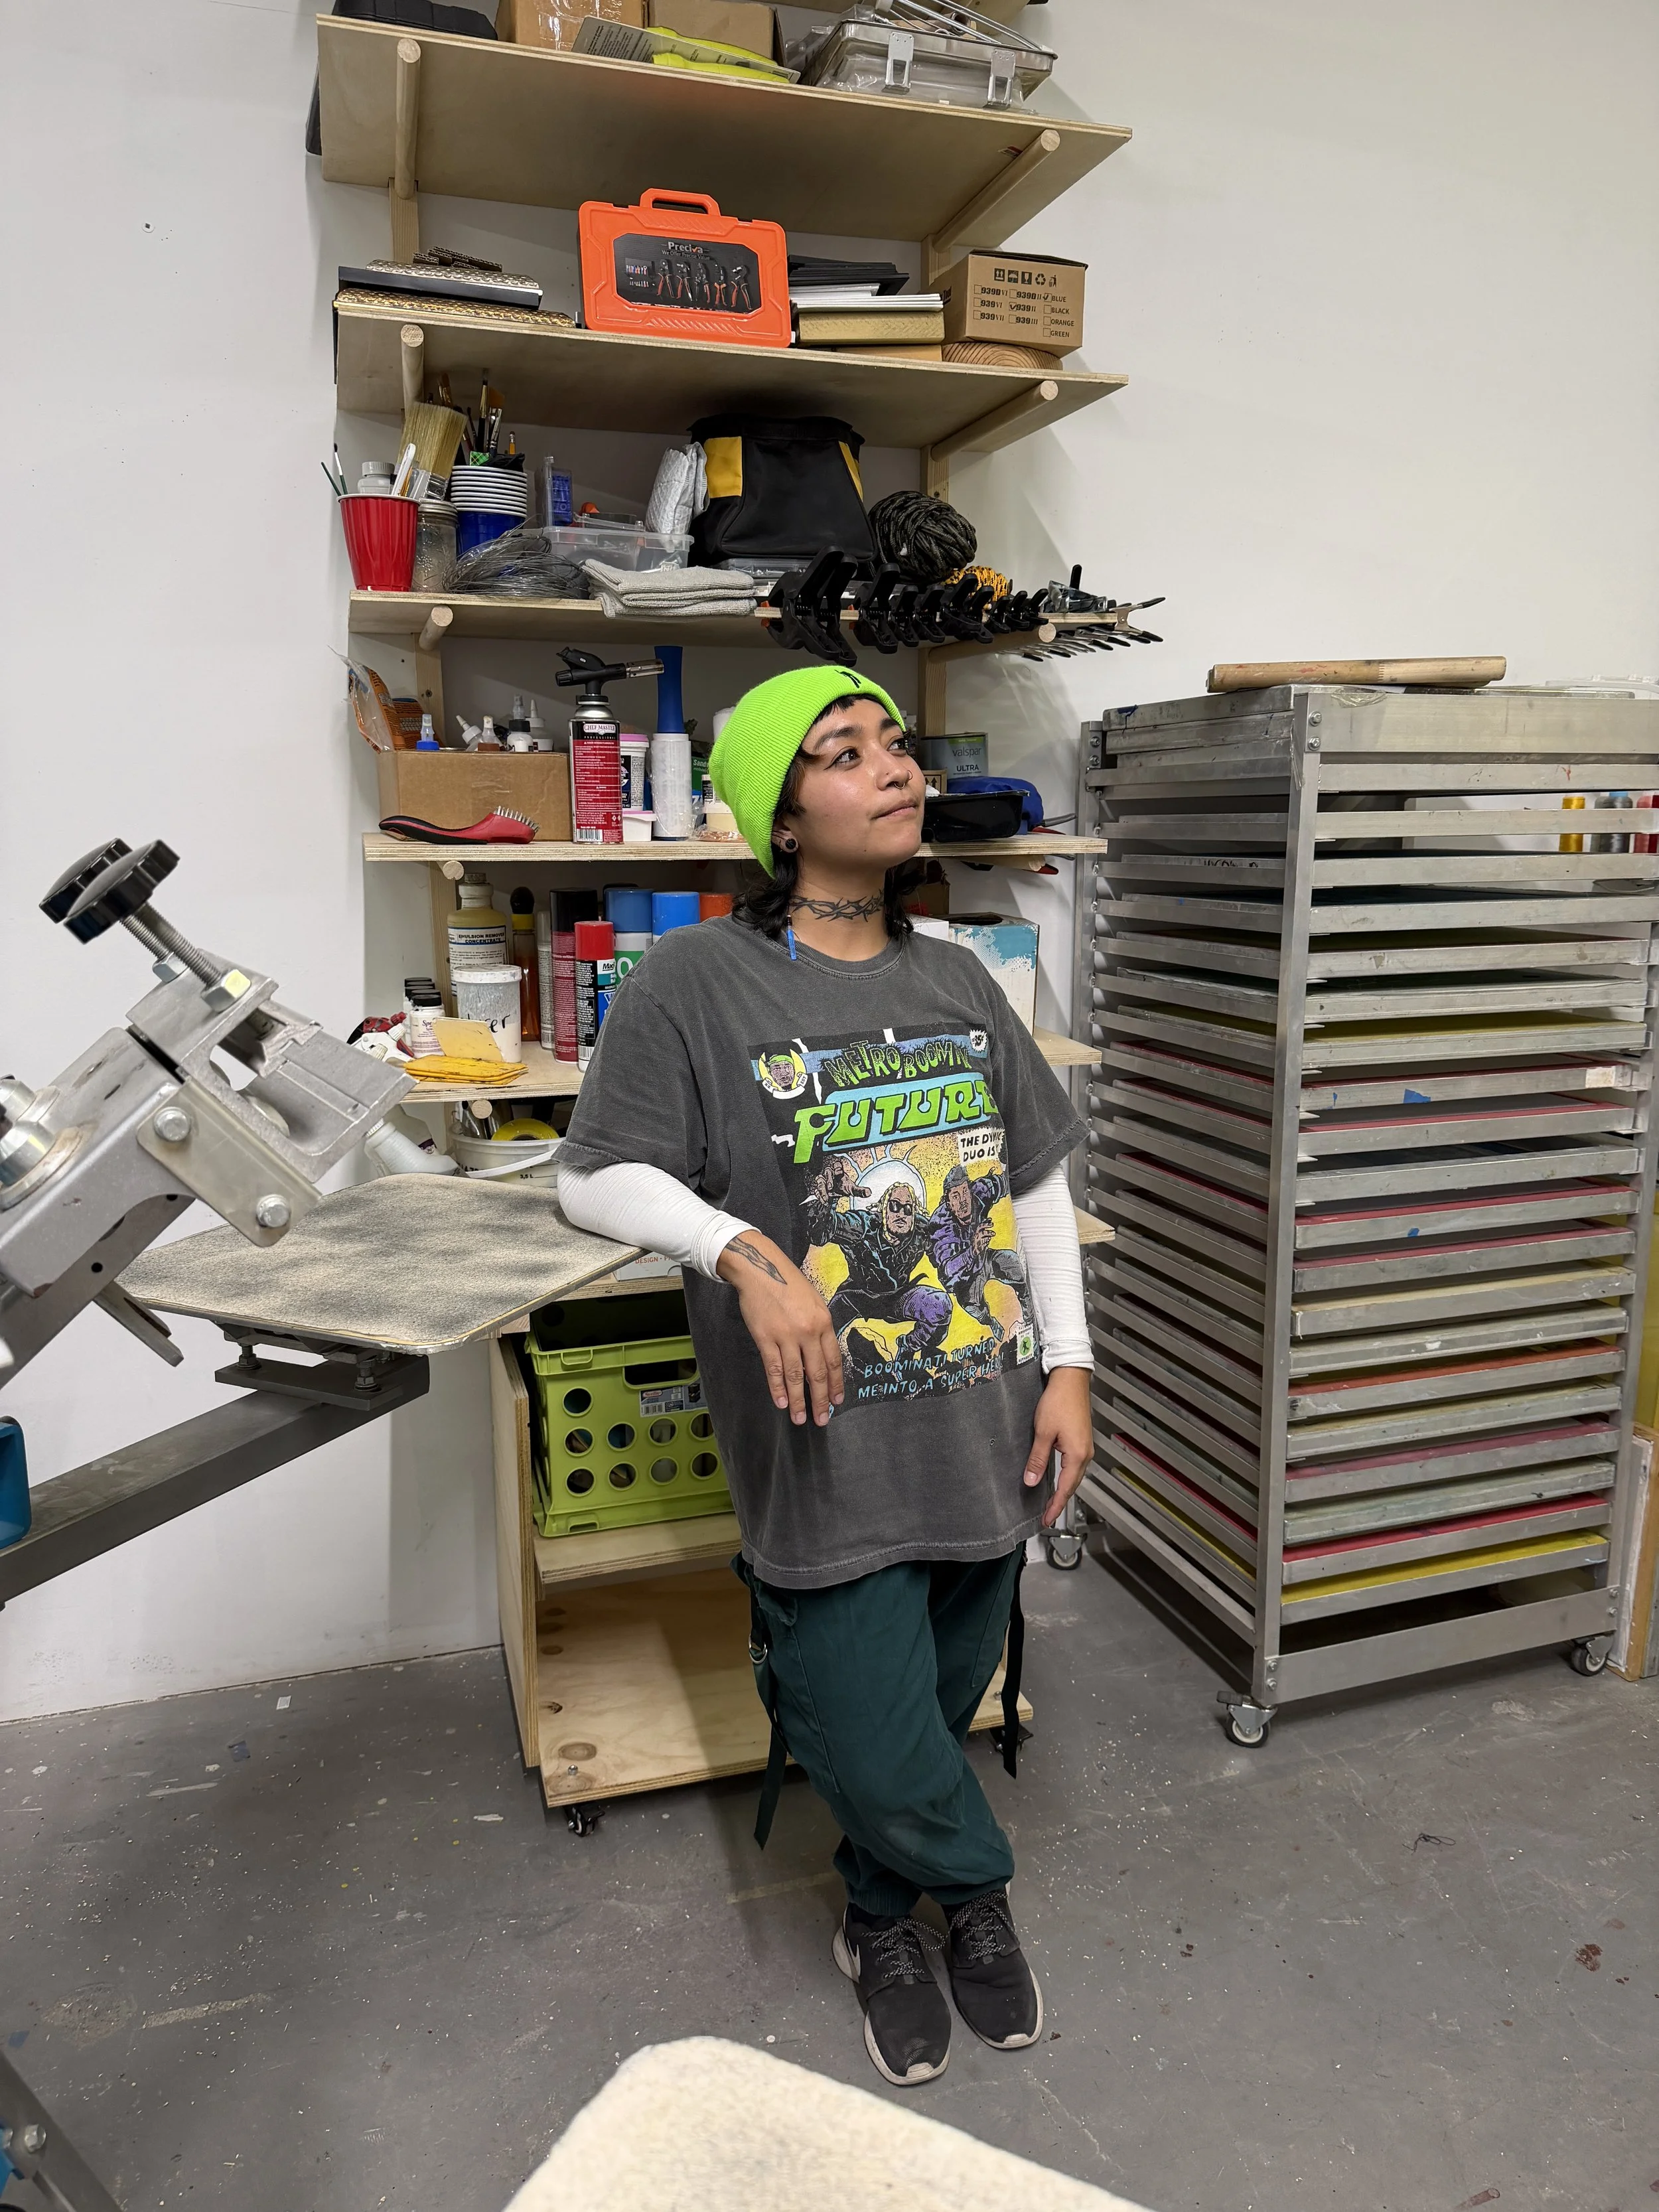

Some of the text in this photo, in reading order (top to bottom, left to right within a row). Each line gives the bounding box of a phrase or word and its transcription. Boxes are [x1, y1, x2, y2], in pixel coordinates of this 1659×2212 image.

[952, 746, 983, 758] valspar
[824, 1040, 901, 1087] METRO
[794, 1080, 999, 1163] FUTURE
[960, 1136, 980, 1148] THE
[963, 1148, 985, 1162] DUO
[951, 1338, 995, 1363] TURNED
[858, 1385, 879, 1400] ME
[883, 1379, 917, 1395] INTO
[925, 1379, 934, 1390] A
[940, 1365, 977, 1388] SUPER
